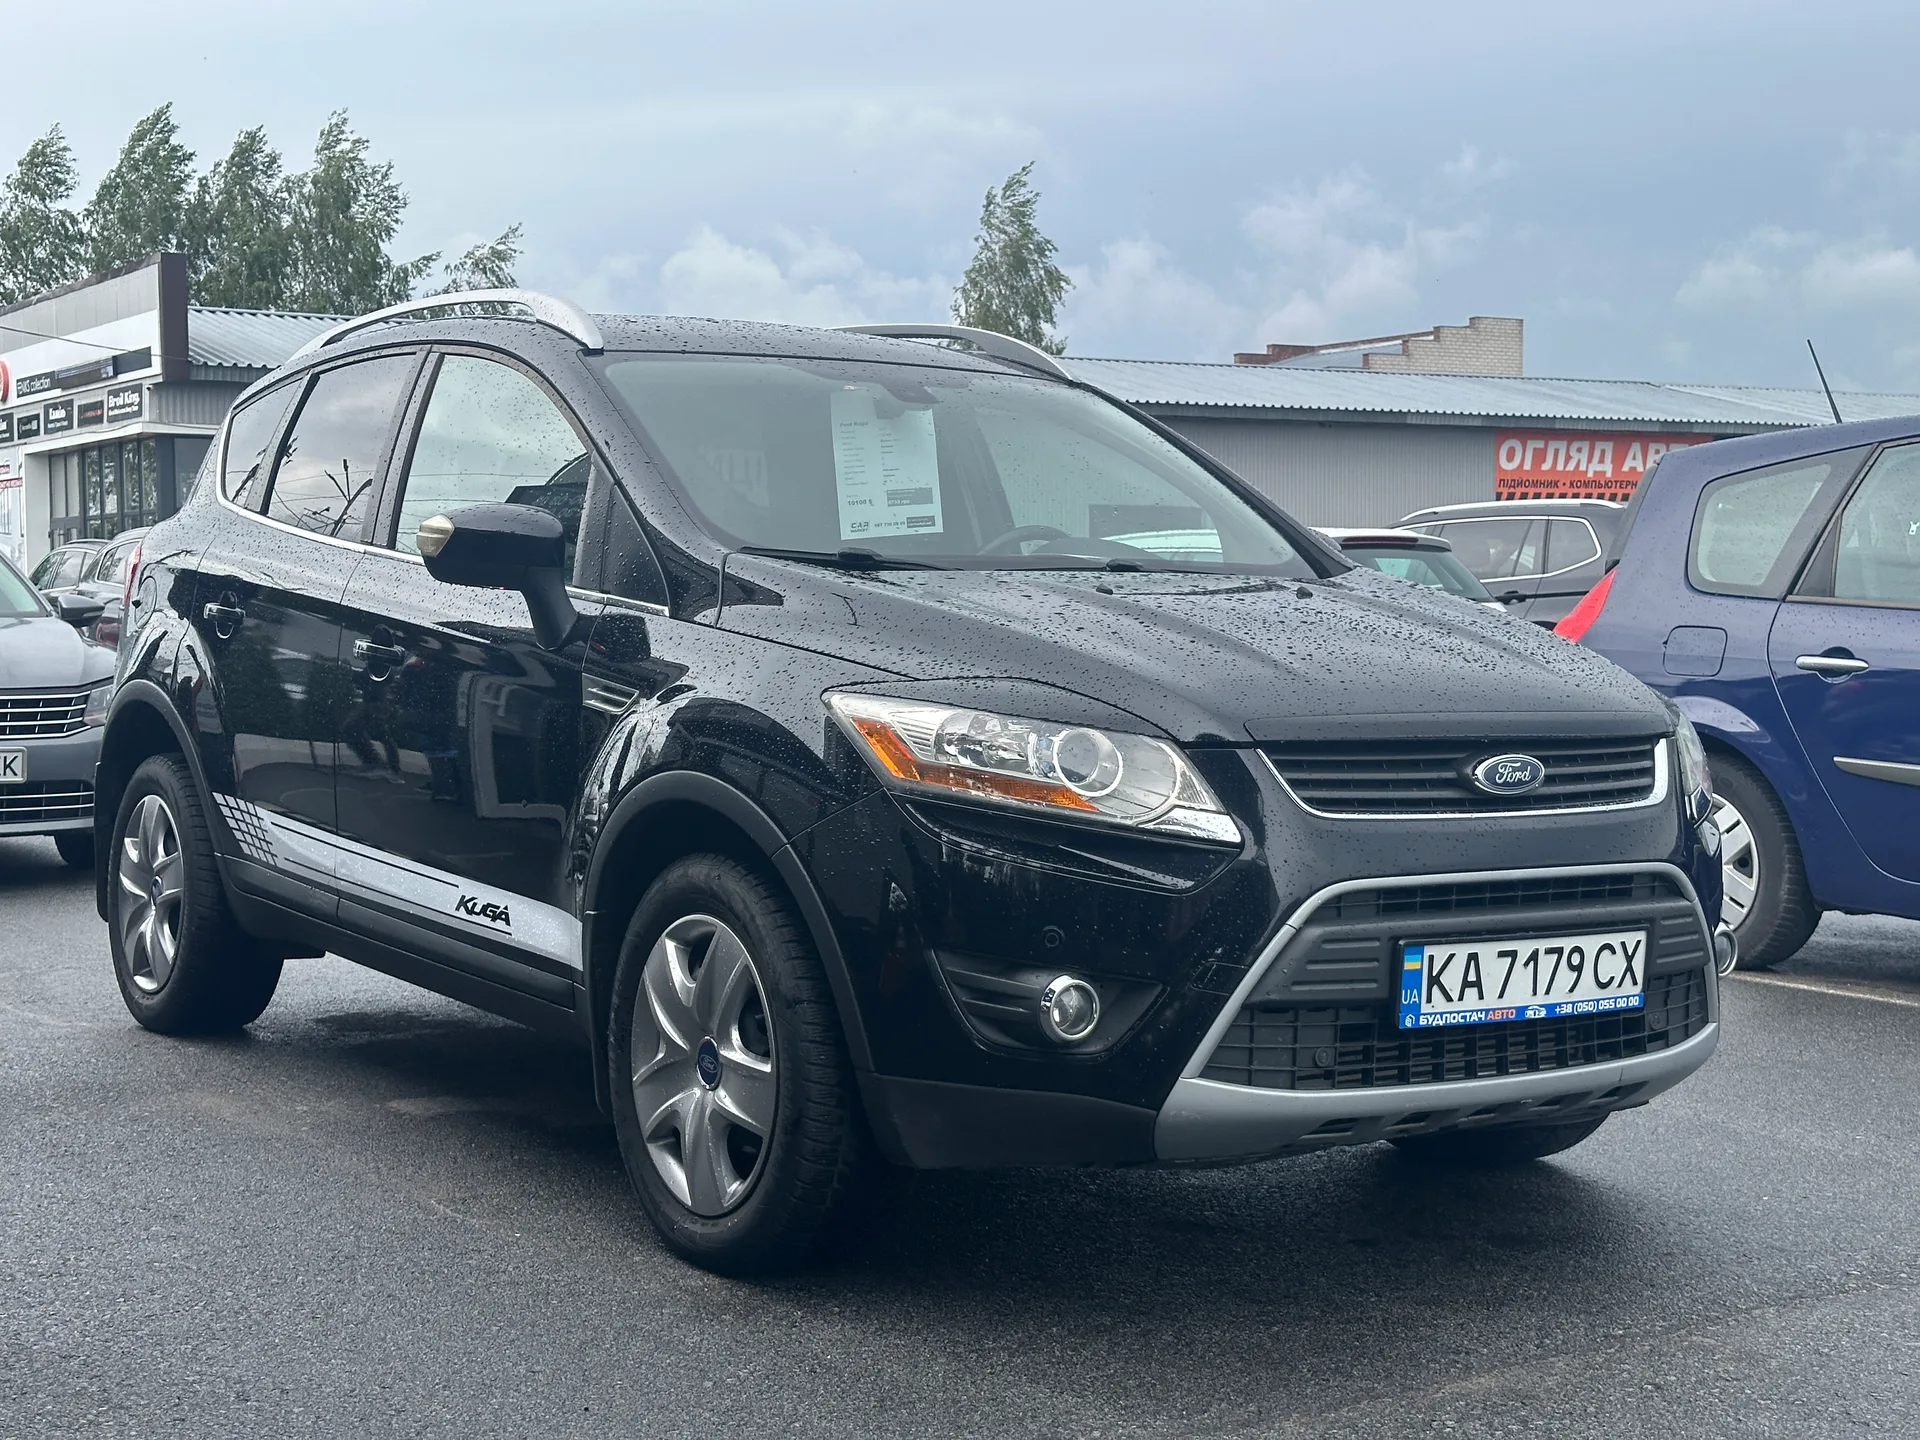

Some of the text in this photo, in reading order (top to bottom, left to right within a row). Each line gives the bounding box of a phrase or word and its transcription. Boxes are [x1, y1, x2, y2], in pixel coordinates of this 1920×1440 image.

[108, 392, 124, 408] Broil
[1498, 438, 1689, 478] ОГЛЯД АВ
[1498, 477, 1560, 490] ПІДЙОМНИК
[1495, 762, 1532, 784] Ford
[1425, 939, 1642, 1004] KA 7179 CX
[1401, 989, 1419, 1005] UA
[1419, 995, 1640, 1026] БУДПОСТАЧ АВТО +38 (050) 055 00 00
